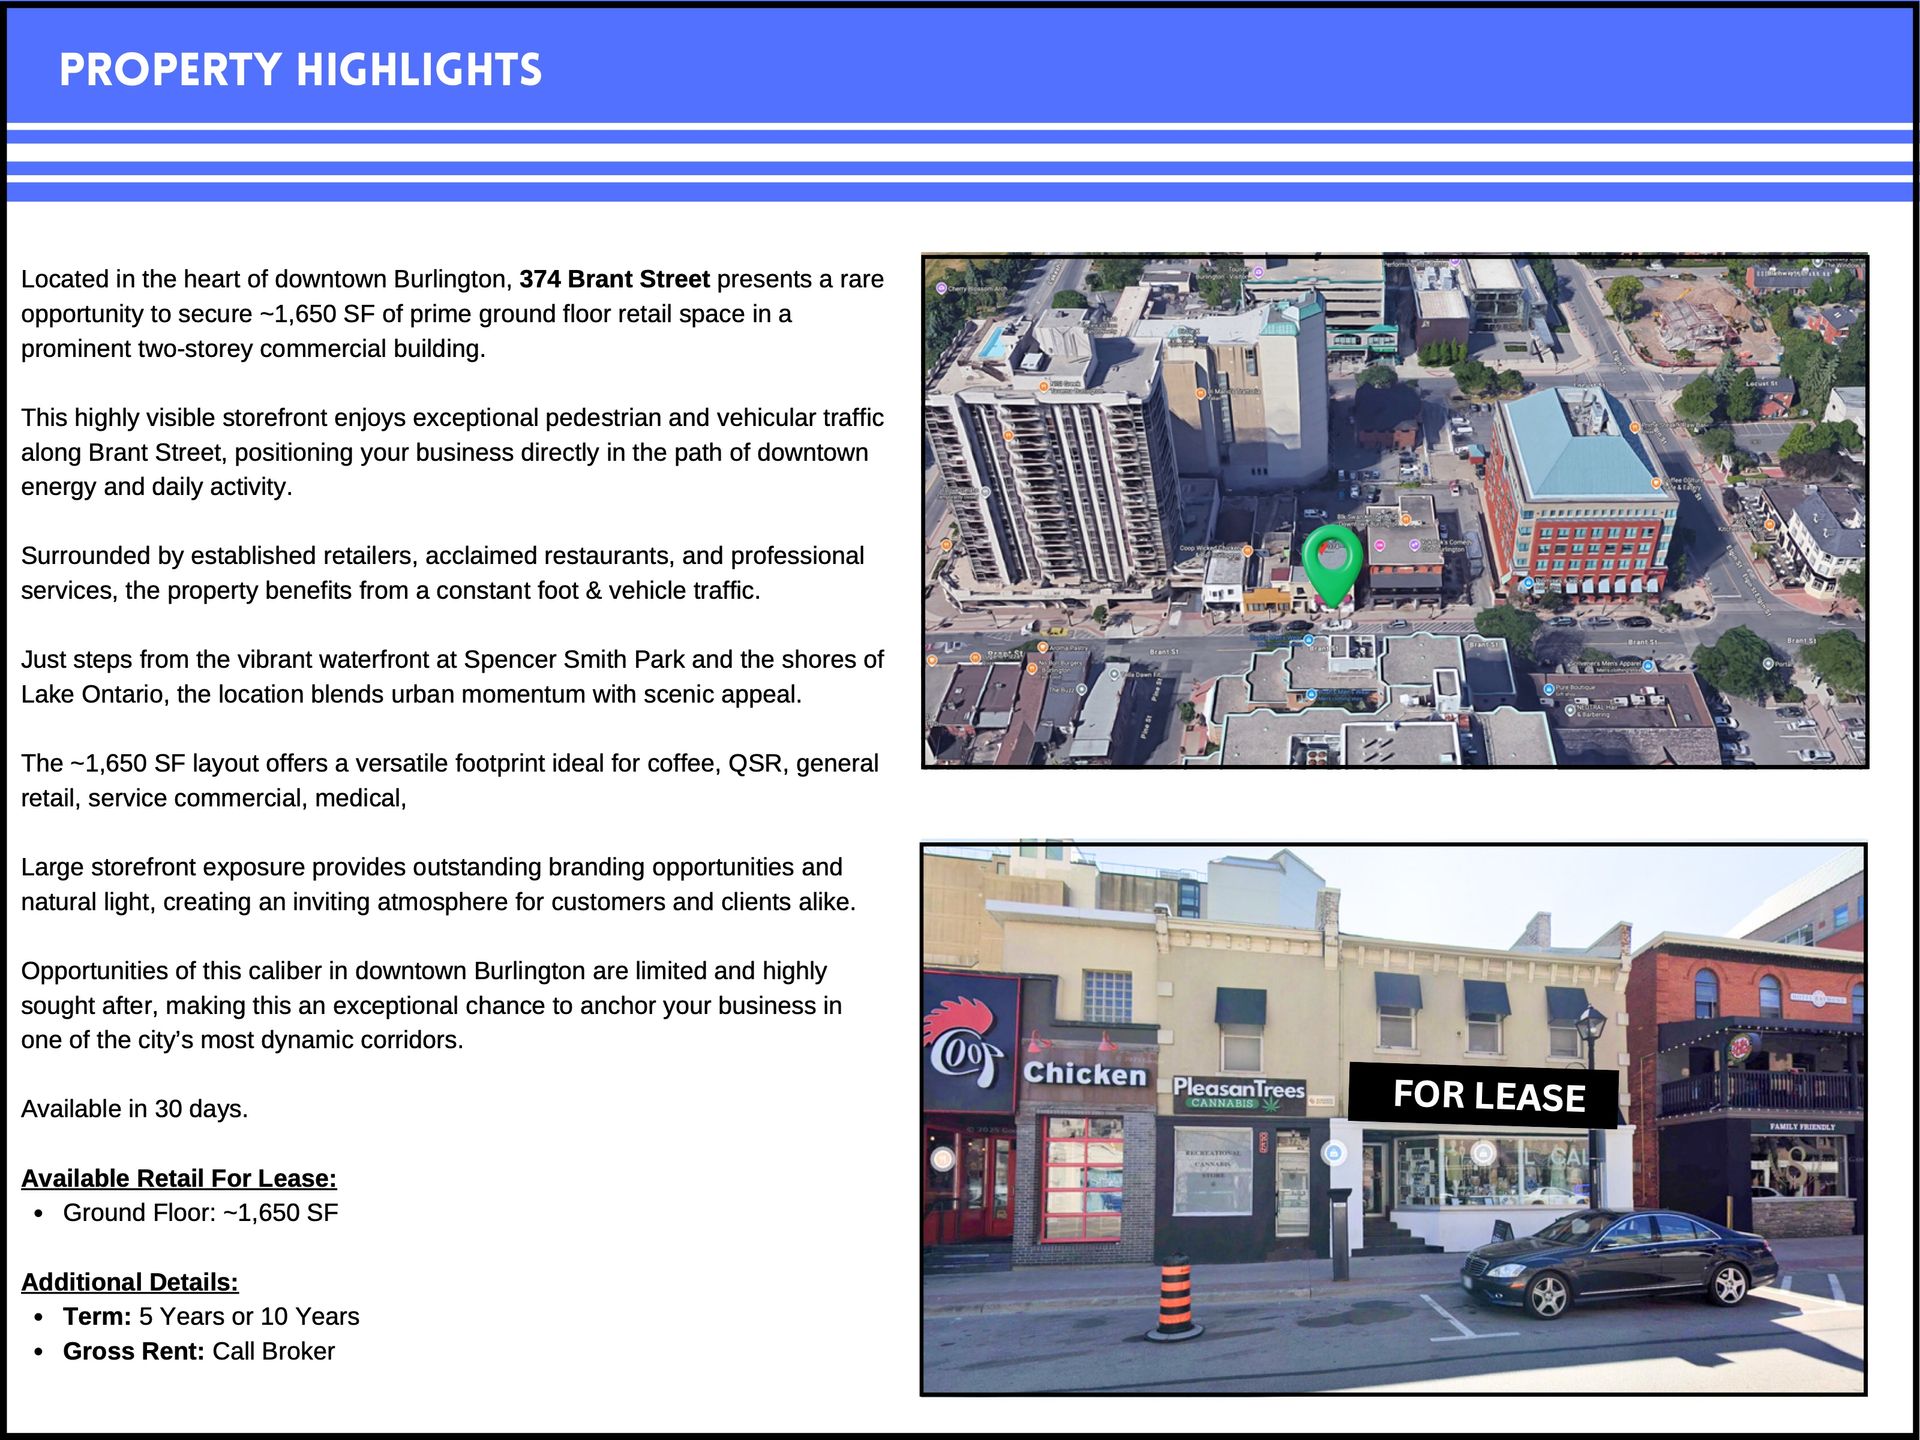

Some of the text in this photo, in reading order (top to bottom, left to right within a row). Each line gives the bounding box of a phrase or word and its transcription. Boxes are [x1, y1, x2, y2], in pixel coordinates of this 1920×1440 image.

[61, 51, 542, 86] PROPERTY HIGHLIGHTS
[22, 268, 885, 294] Located in the heart of downtown Burlington, 374 Brant Street presents a rare
[21, 303, 793, 329] opportunity to secure ~1,650 SF of prime ground floor retail space in a
[21, 337, 485, 363] prominent two-storey commercial building.
[20, 752, 879, 778] The ~1,650 SF layout offers a versatile footprint ideal for coffee, QSR, general
[21, 787, 406, 811] retail, service commercial, medical,
[1023, 1060, 1147, 1087] Chicken
[1173, 1076, 1305, 1099] PleasanTrees
[1191, 1098, 1254, 1109] CANNABIS
[1769, 1123, 1836, 1131] FAMILY FRIENDLY
[21, 1167, 336, 1188] Available Retail For Lease:
[63, 1201, 339, 1225] Ground Floor: ~1,650 SF
[20, 1271, 238, 1292] Additional Details:
[62, 1306, 360, 1326] Term: 5 Years or 10 Years
[63, 1340, 336, 1361] Gross Rent: Call Broker
